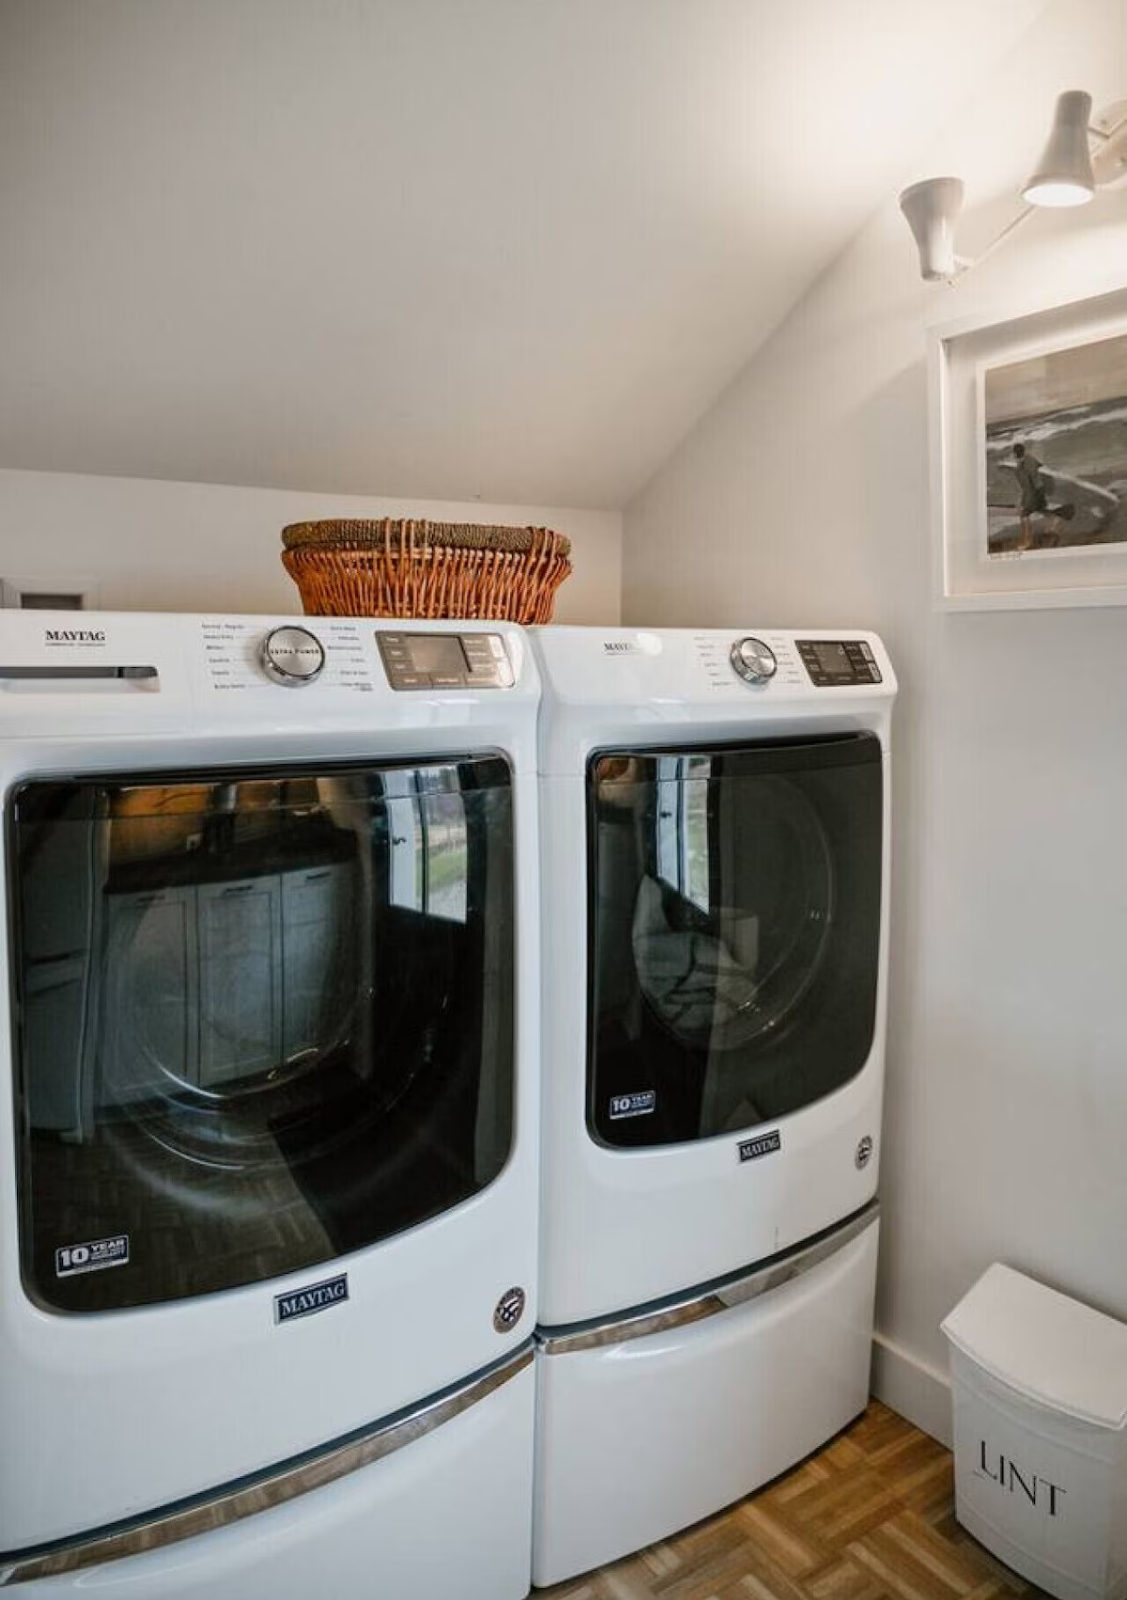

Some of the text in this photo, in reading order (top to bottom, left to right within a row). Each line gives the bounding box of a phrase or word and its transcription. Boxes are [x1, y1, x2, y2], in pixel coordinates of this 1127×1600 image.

[46, 630, 106, 641] MAYTAG
[612, 1097, 631, 1112] 10
[741, 1136, 780, 1159] MAYTAG
[60, 1246, 90, 1267] 10
[90, 1239, 125, 1252] YEAR
[281, 1282, 345, 1316] MAYTAG
[973, 1440, 1068, 1516] LINT
